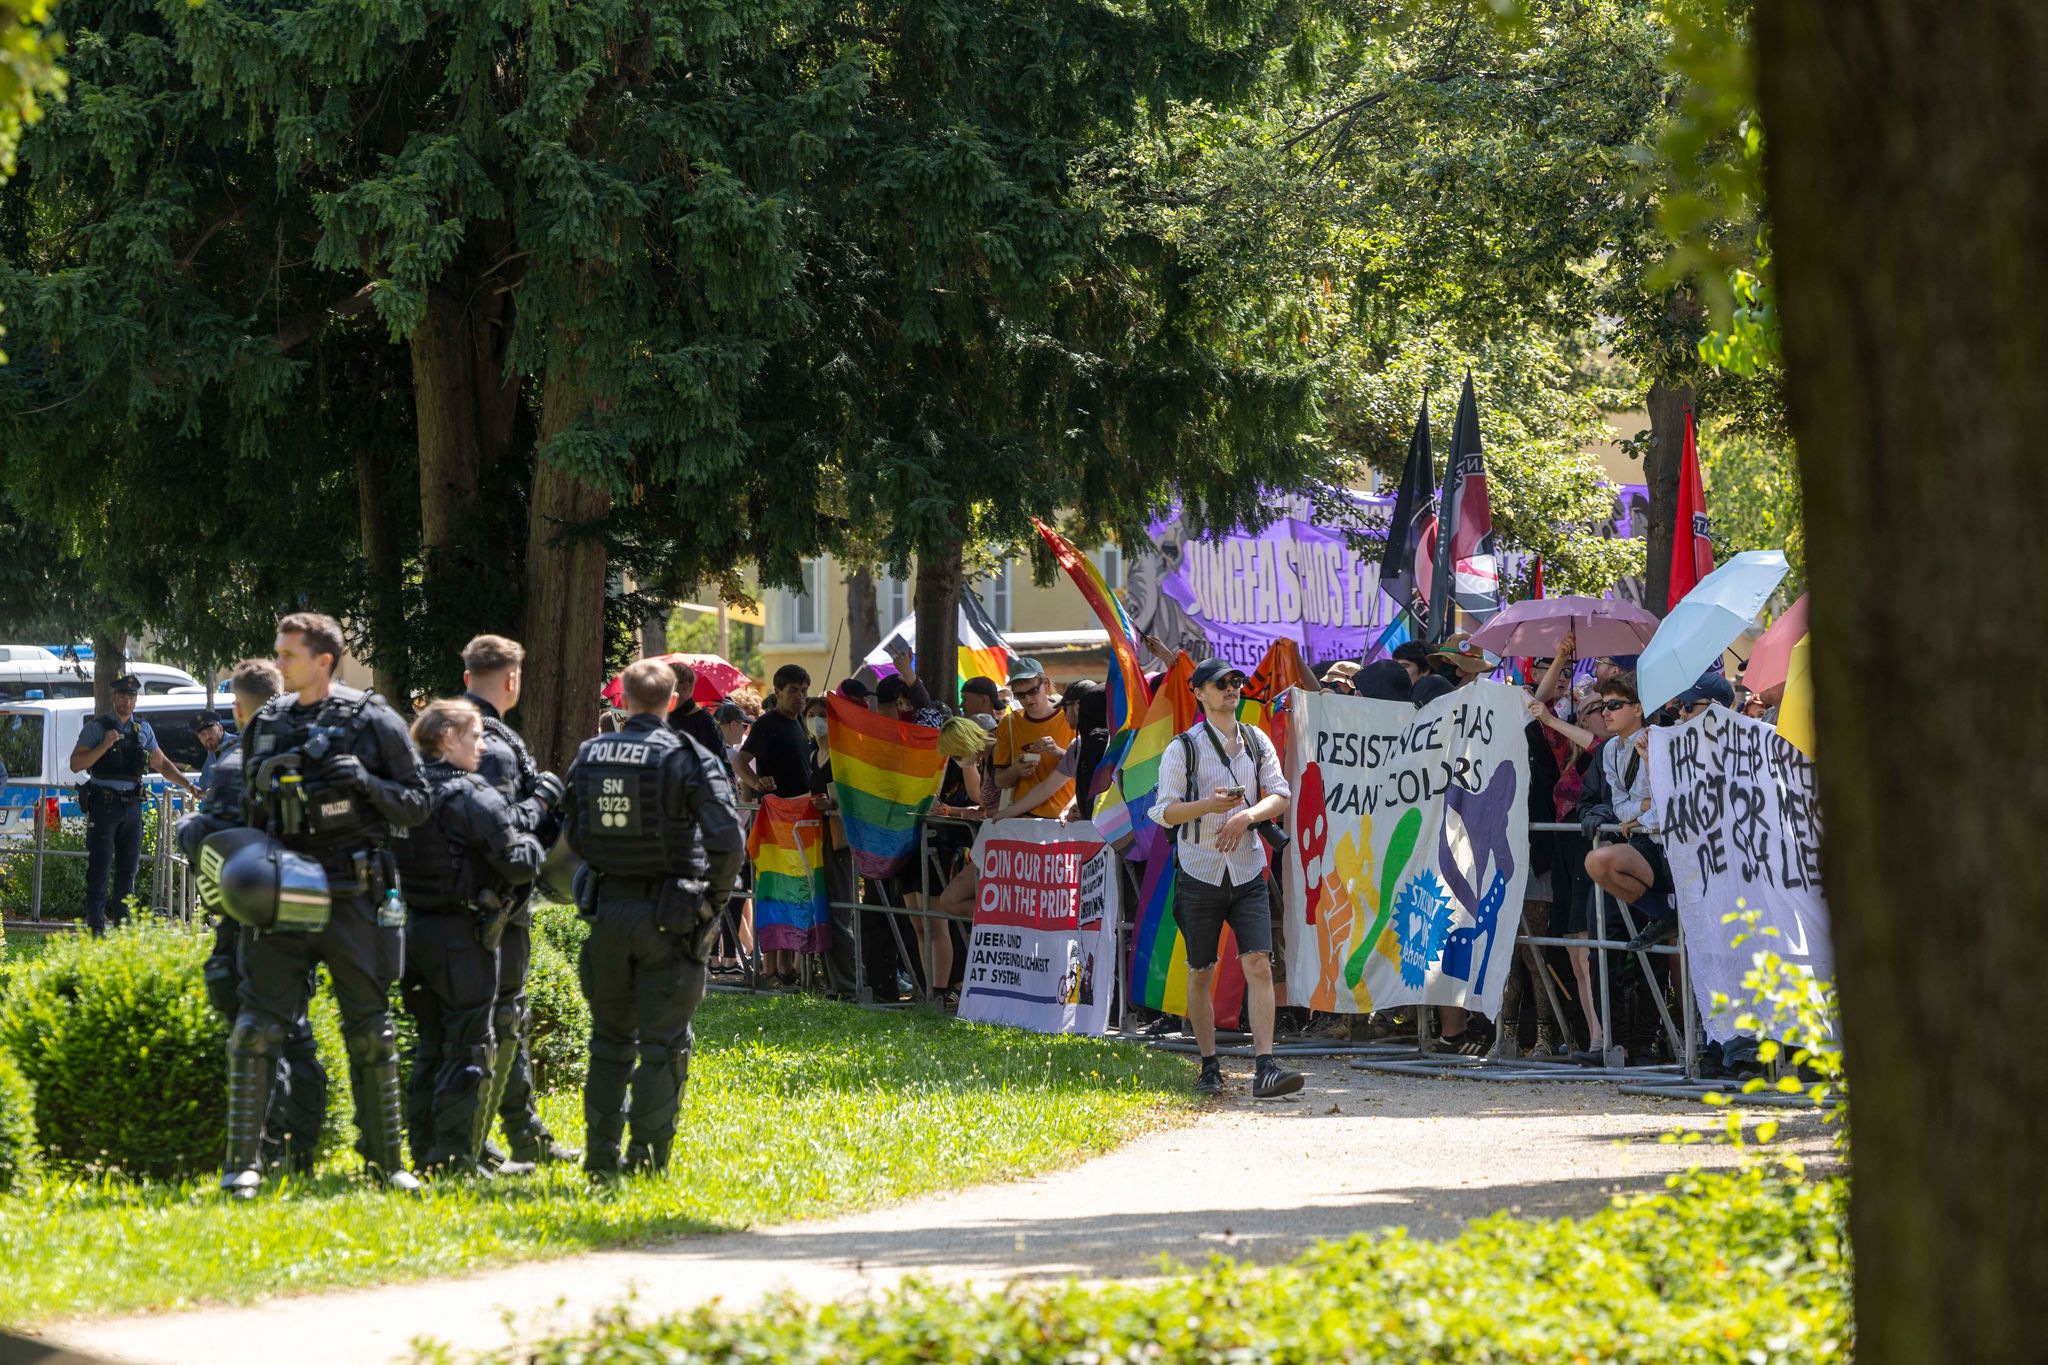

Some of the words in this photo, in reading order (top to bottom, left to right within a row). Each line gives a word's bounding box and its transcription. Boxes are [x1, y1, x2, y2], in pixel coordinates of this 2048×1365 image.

[1453, 703, 1494, 745] HAS
[587, 742, 650, 765] POLIZEI
[1669, 727, 1706, 788] IHR
[602, 778, 624, 794] SN
[1322, 780, 1383, 815] MAN
[1384, 756, 1482, 807] COLORS
[596, 796, 631, 812] 13/23
[1661, 771, 1727, 851] ANGST
[1014, 850, 1041, 884] OUR
[1043, 853, 1082, 885] FIGHT
[977, 882, 1012, 913] OIN
[1014, 883, 1037, 918] THE
[1039, 888, 1078, 919] PRIDE
[974, 931, 1006, 948] UEER-
[1007, 933, 1022, 949] UND
[969, 966, 987, 982] AT
